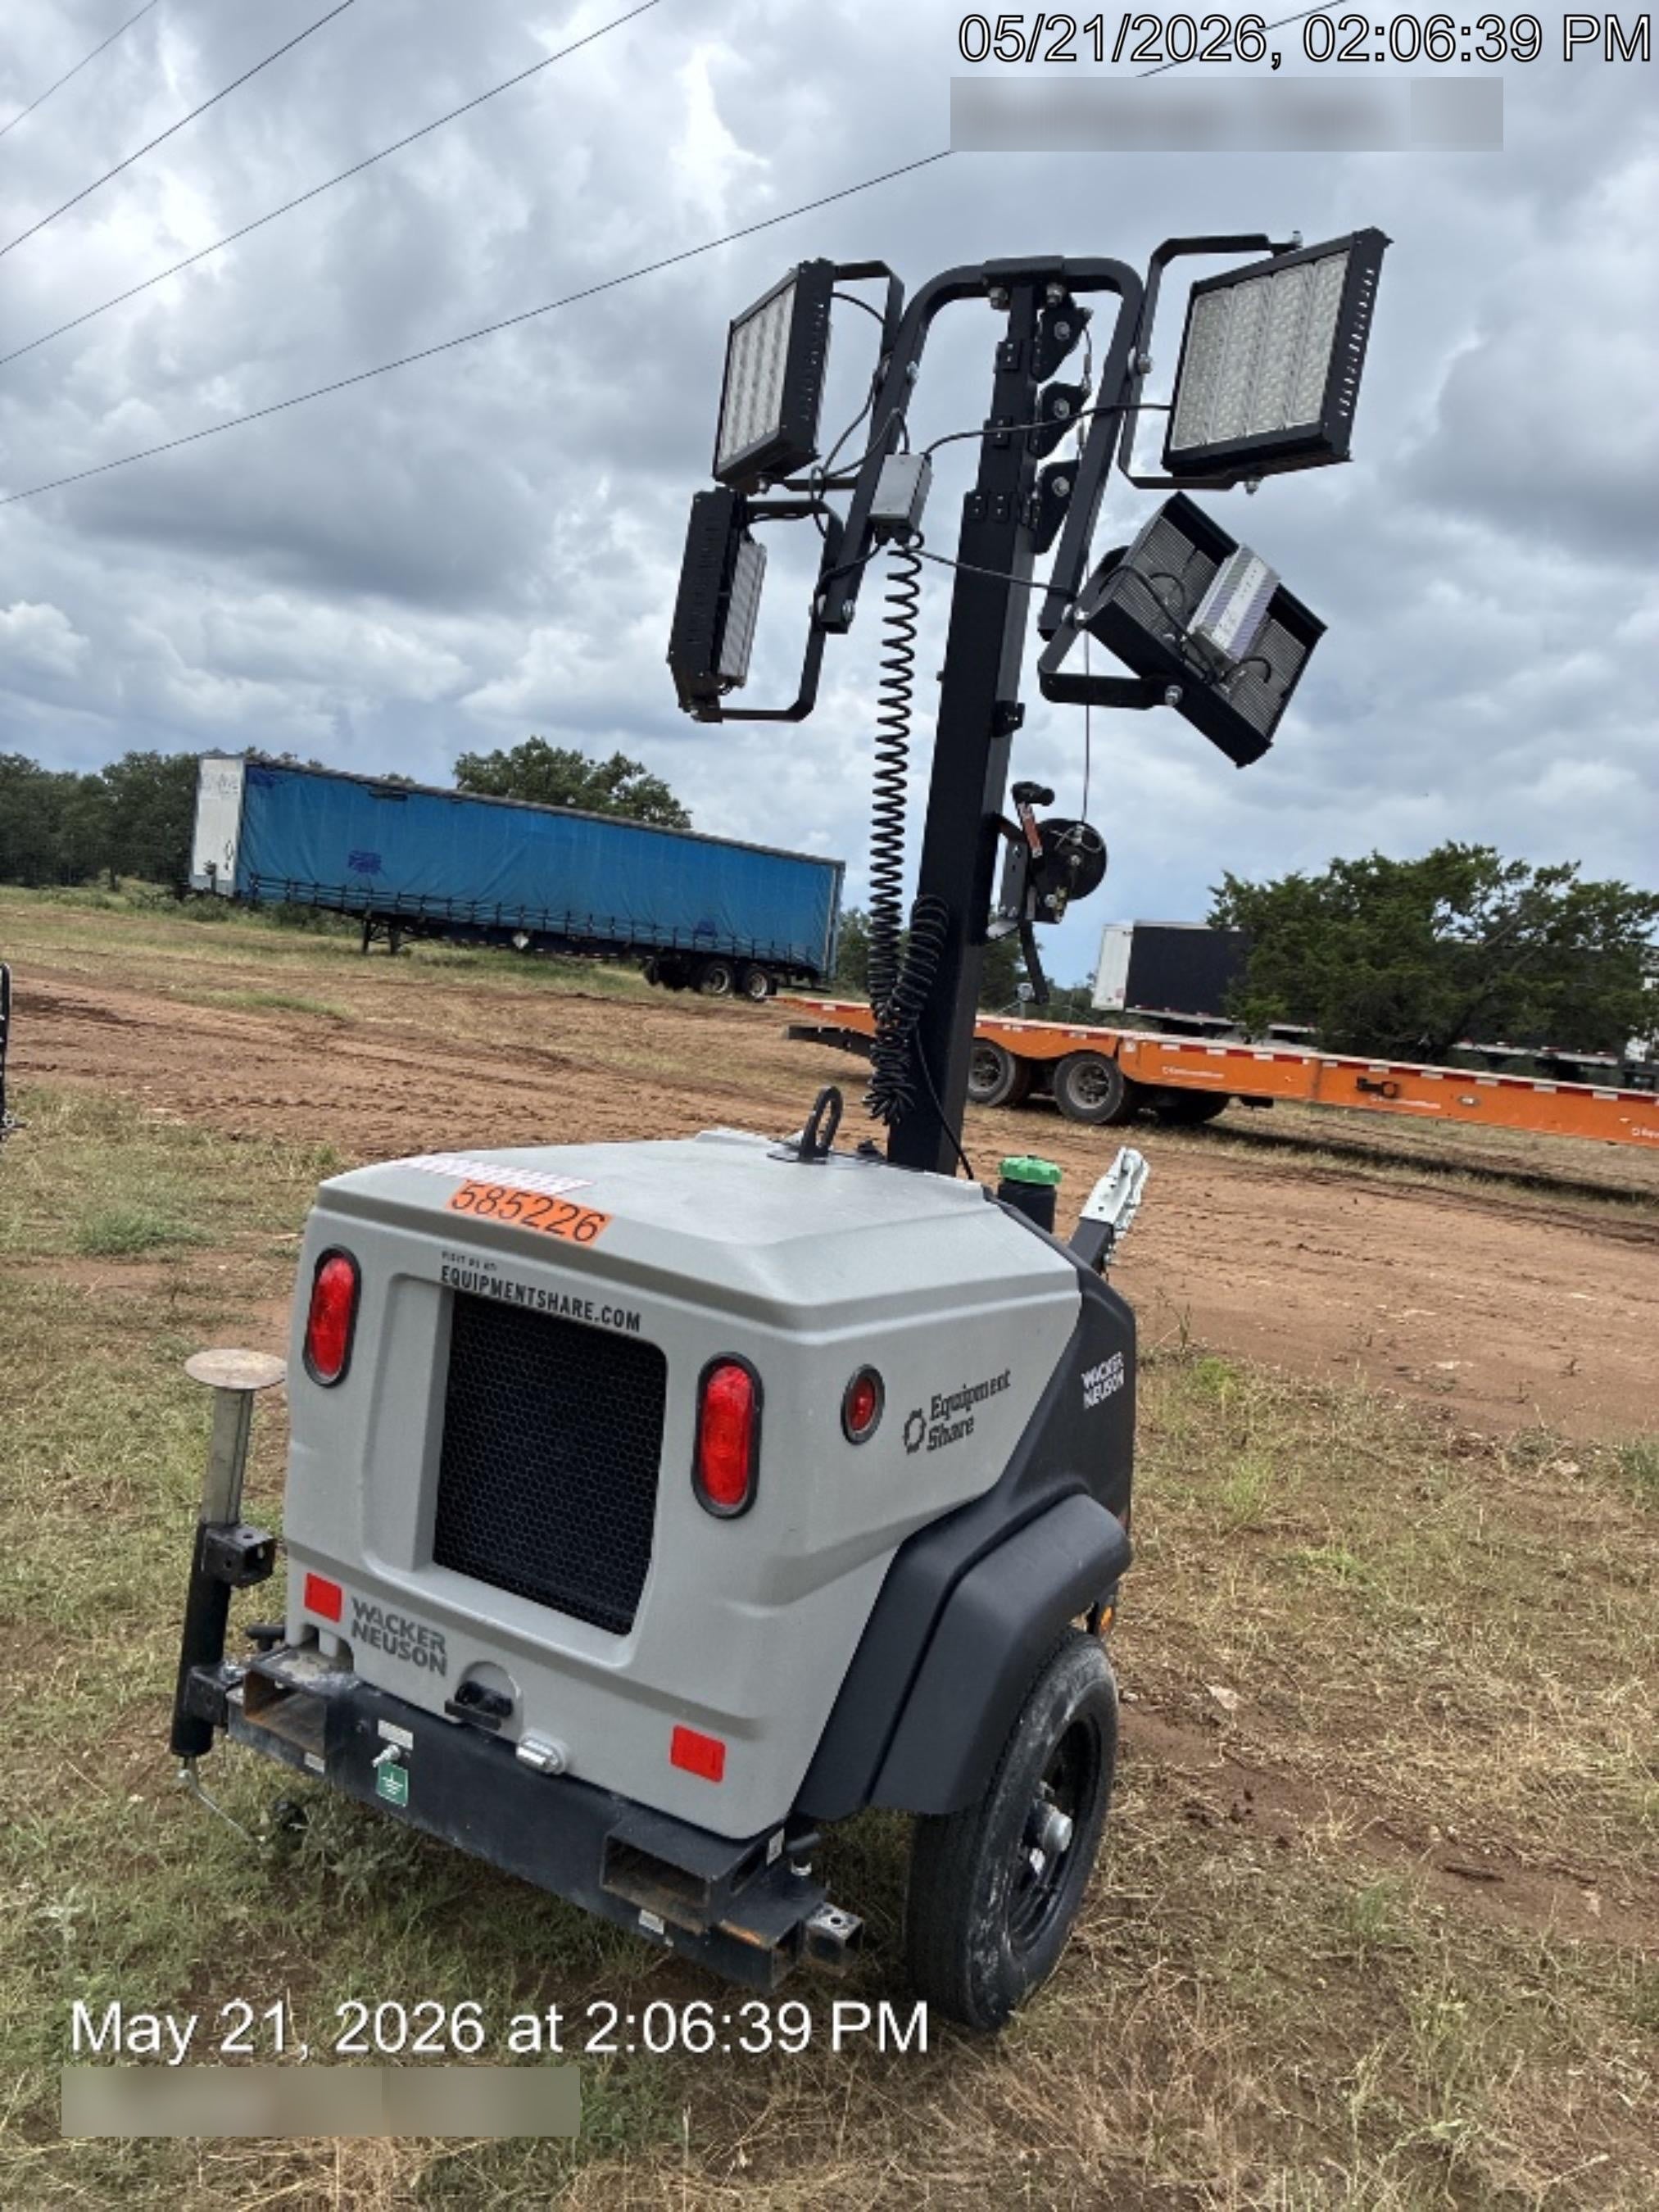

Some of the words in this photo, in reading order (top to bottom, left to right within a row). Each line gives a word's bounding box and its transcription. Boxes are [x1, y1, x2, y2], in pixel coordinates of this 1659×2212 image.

[452, 1183, 606, 1243] 585226
[441, 1264, 641, 1333] EQUIPMENTSHARE.COM
[930, 1367, 1011, 1421] Equipment
[926, 1416, 975, 1452] Share
[351, 1598, 446, 1655] WACKER
[351, 1620, 447, 1677] NEUSON
